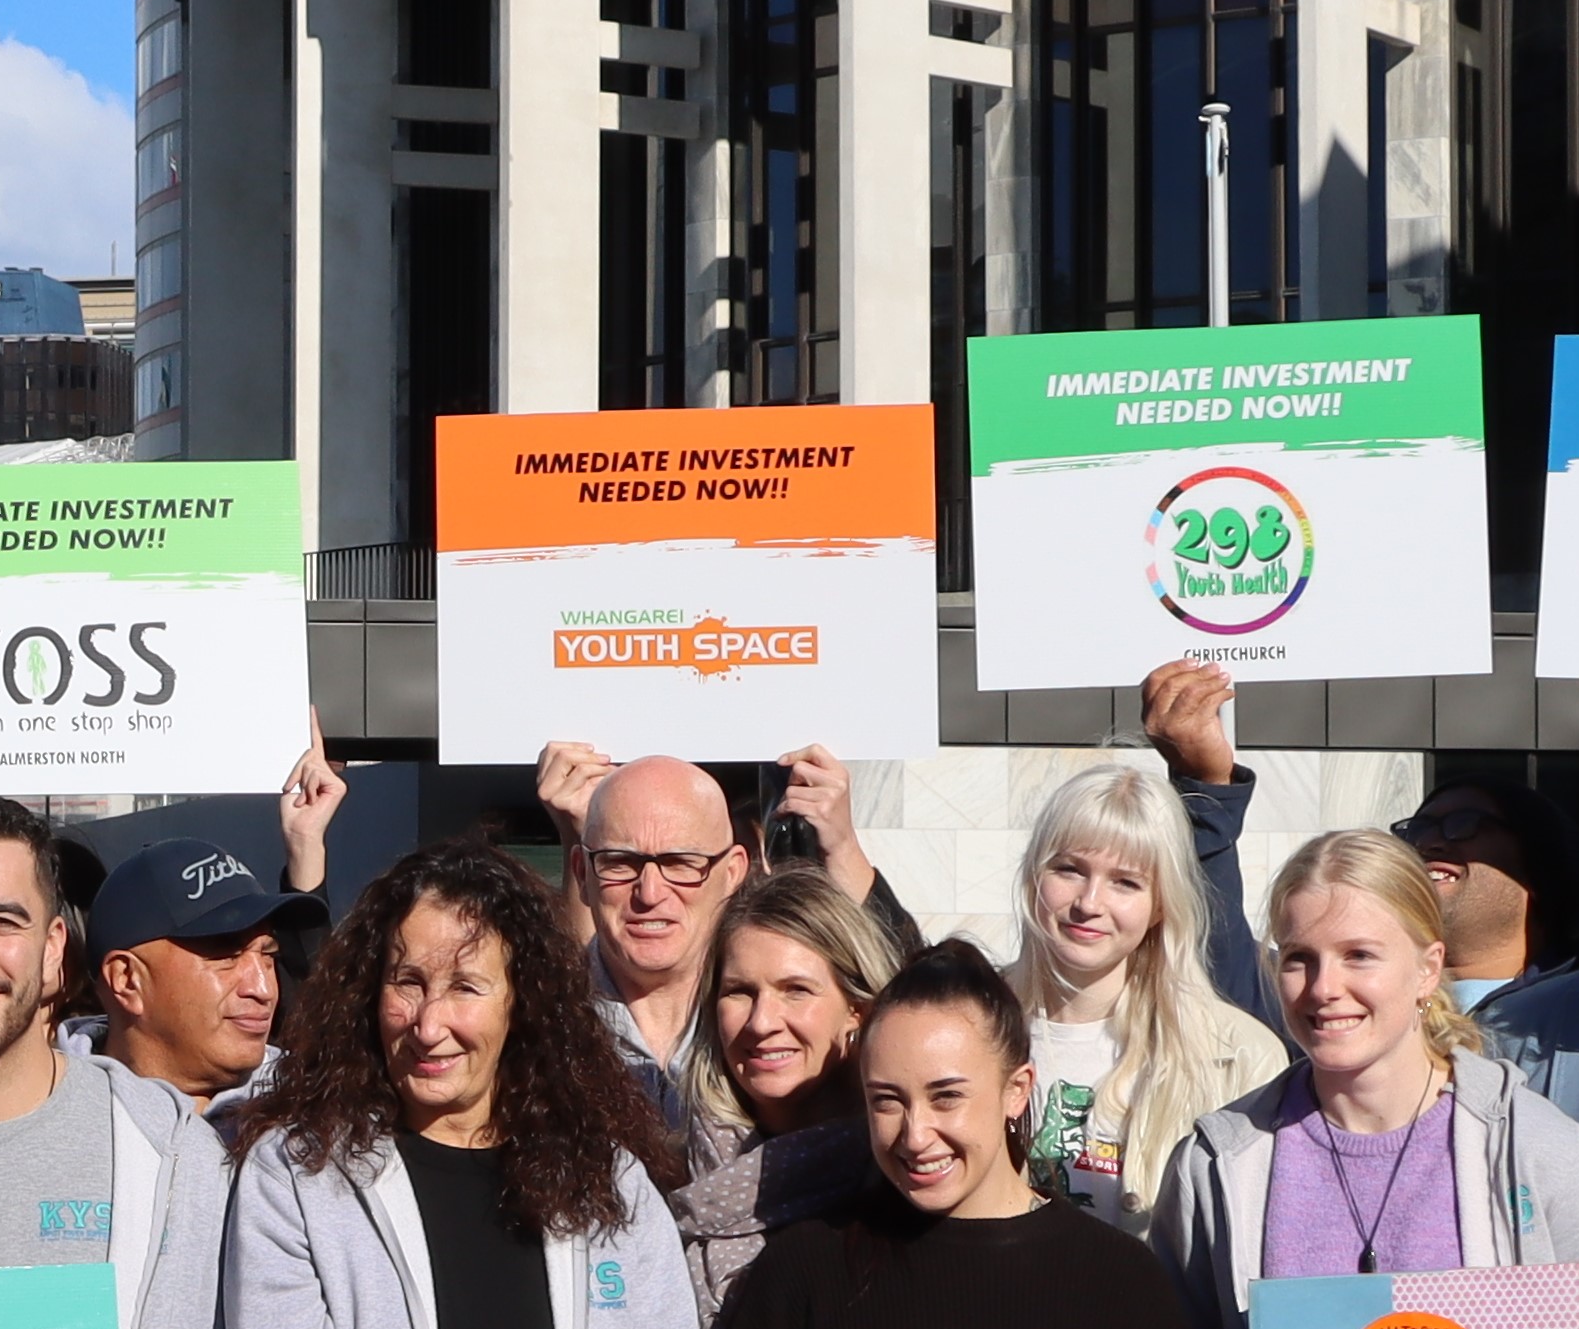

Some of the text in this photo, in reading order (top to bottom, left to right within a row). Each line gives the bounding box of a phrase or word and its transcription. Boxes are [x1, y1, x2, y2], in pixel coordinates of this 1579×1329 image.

[1046, 358, 1412, 397] IMMEDIATE INVESTMENT
[1115, 392, 1342, 426] NEEDED NOW!!
[515, 446, 855, 475] IMMEDIATE INVESTMENT
[578, 477, 790, 503] NEEDED NOW!!
[49, 498, 234, 522] INVESTMENT
[68, 527, 168, 550] NOW!!
[1171, 505, 1291, 569] 298
[1174, 557, 1289, 598] Youth Health
[560, 609, 684, 625] WHANGAREI
[559, 631, 815, 663] YOUTH SPACE
[18, 715, 57, 733] one
[71, 711, 114, 736] stop
[127, 709, 173, 734] shop
[80, 750, 126, 765] NORTH
[39, 1200, 112, 1229] KYS
